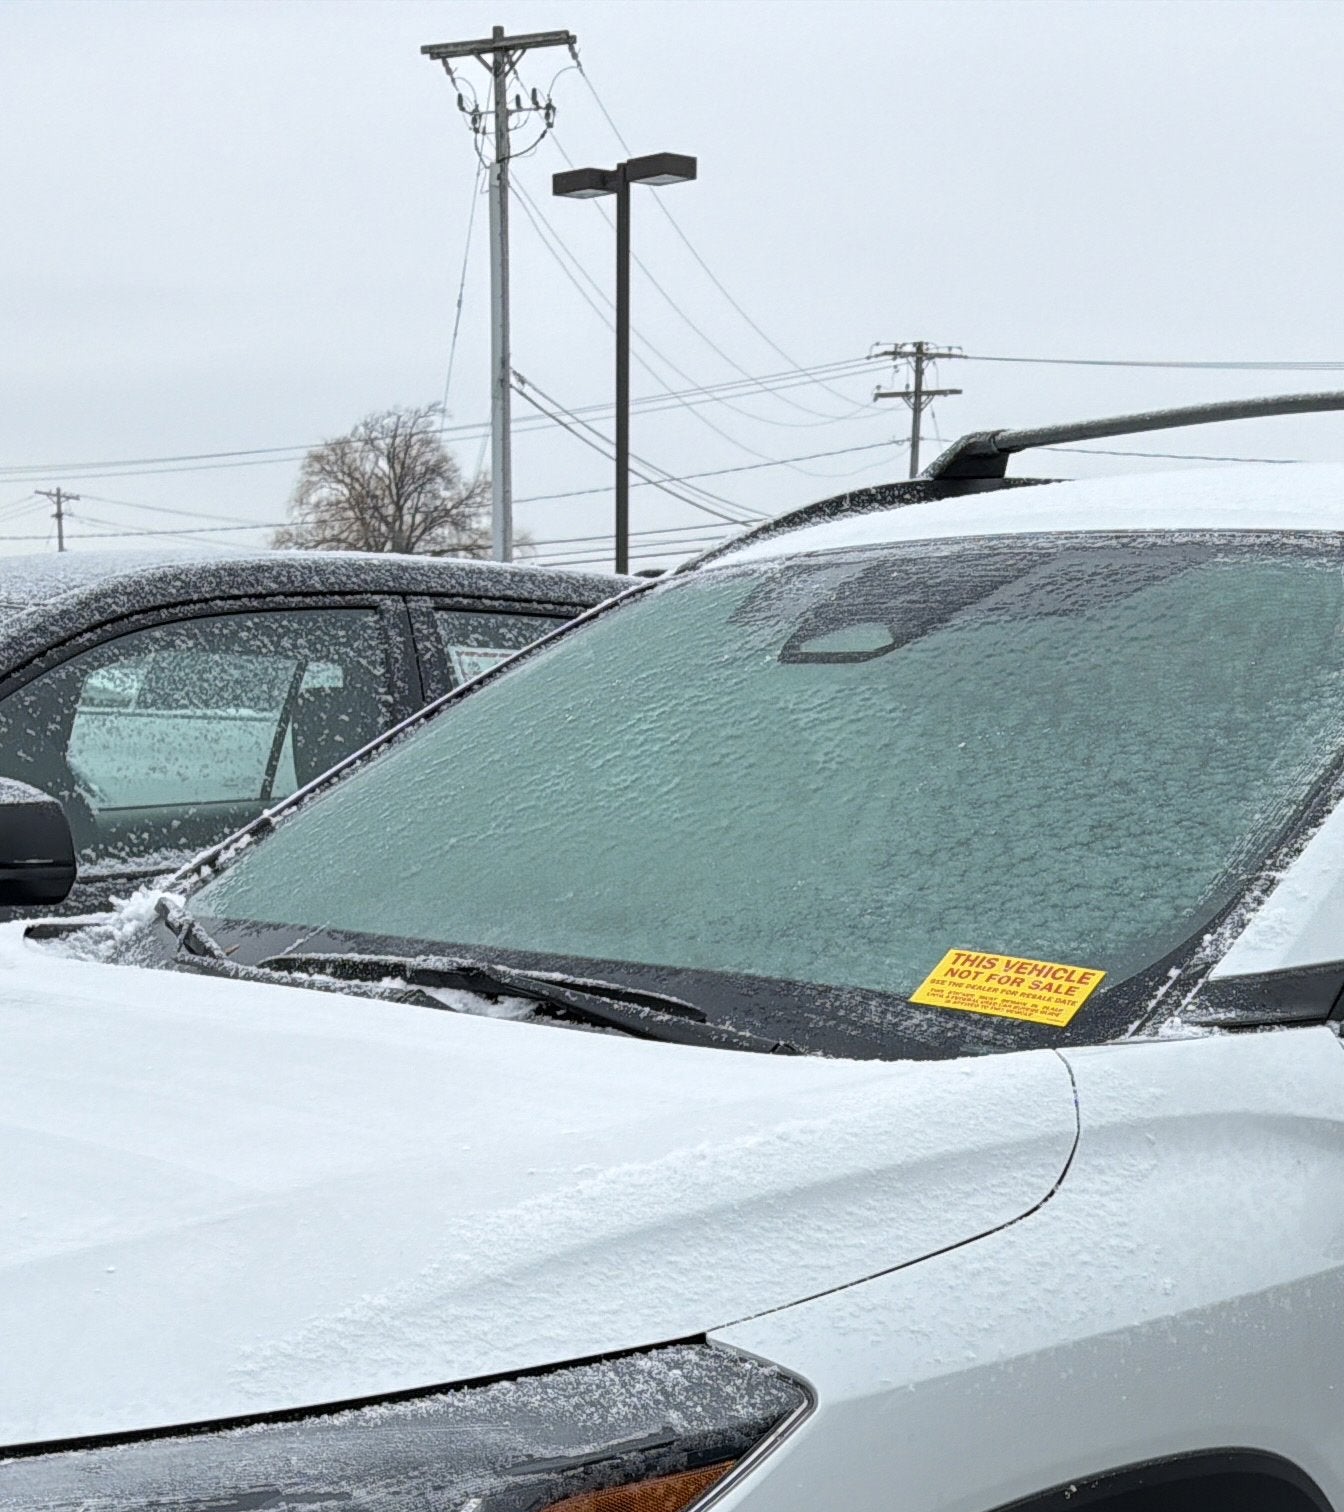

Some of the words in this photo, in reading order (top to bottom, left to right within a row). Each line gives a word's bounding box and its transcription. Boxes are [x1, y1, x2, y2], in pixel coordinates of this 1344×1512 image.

[943, 967, 985, 981] NOT
[984, 973, 1026, 988] FOR
[1028, 979, 1080, 997] SALE
[951, 952, 1000, 970] THIS
[1003, 959, 1096, 986] VEHICLE
[964, 983, 1000, 994] DEALER
[999, 988, 1020, 997] FOR
[1019, 991, 1054, 1003] RESALE
[1054, 997, 1079, 1007] DATE
